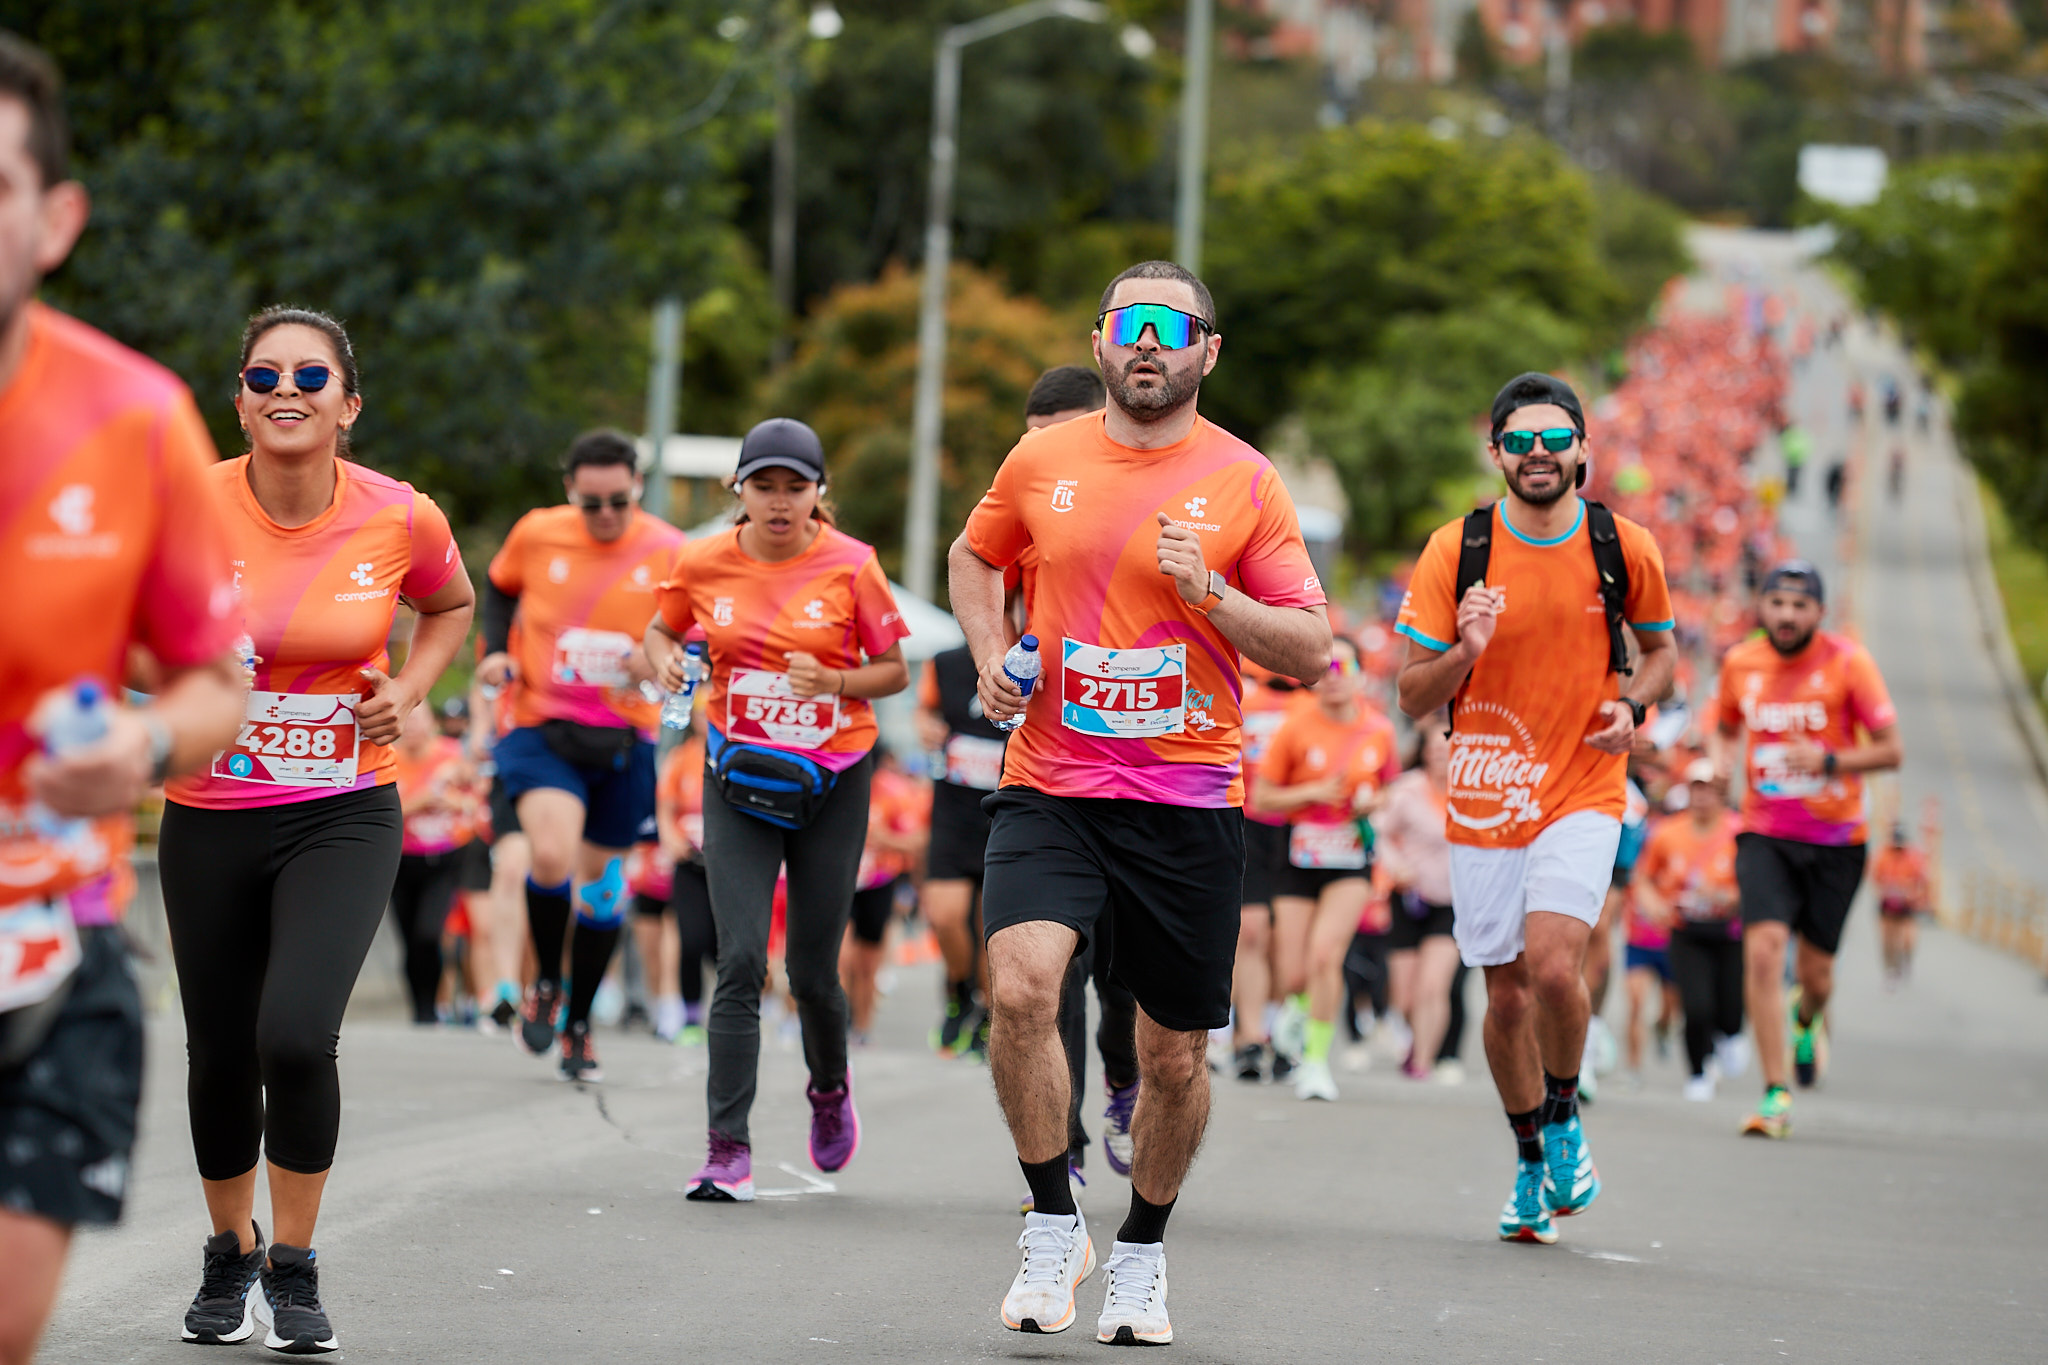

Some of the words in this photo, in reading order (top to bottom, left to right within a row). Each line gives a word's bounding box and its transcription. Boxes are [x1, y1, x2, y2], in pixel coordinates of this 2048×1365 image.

[1051, 486, 1075, 506] fit
[1174, 519, 1221, 532] ompensar
[1079, 678, 1159, 709] 2715
[745, 697, 818, 726] 5736
[1072, 709, 1079, 722] A
[235, 724, 336, 757] 4288
[1454, 732, 1511, 747] Carrera
[233, 759, 246, 773] A
[1449, 745, 1549, 790] Atlética
